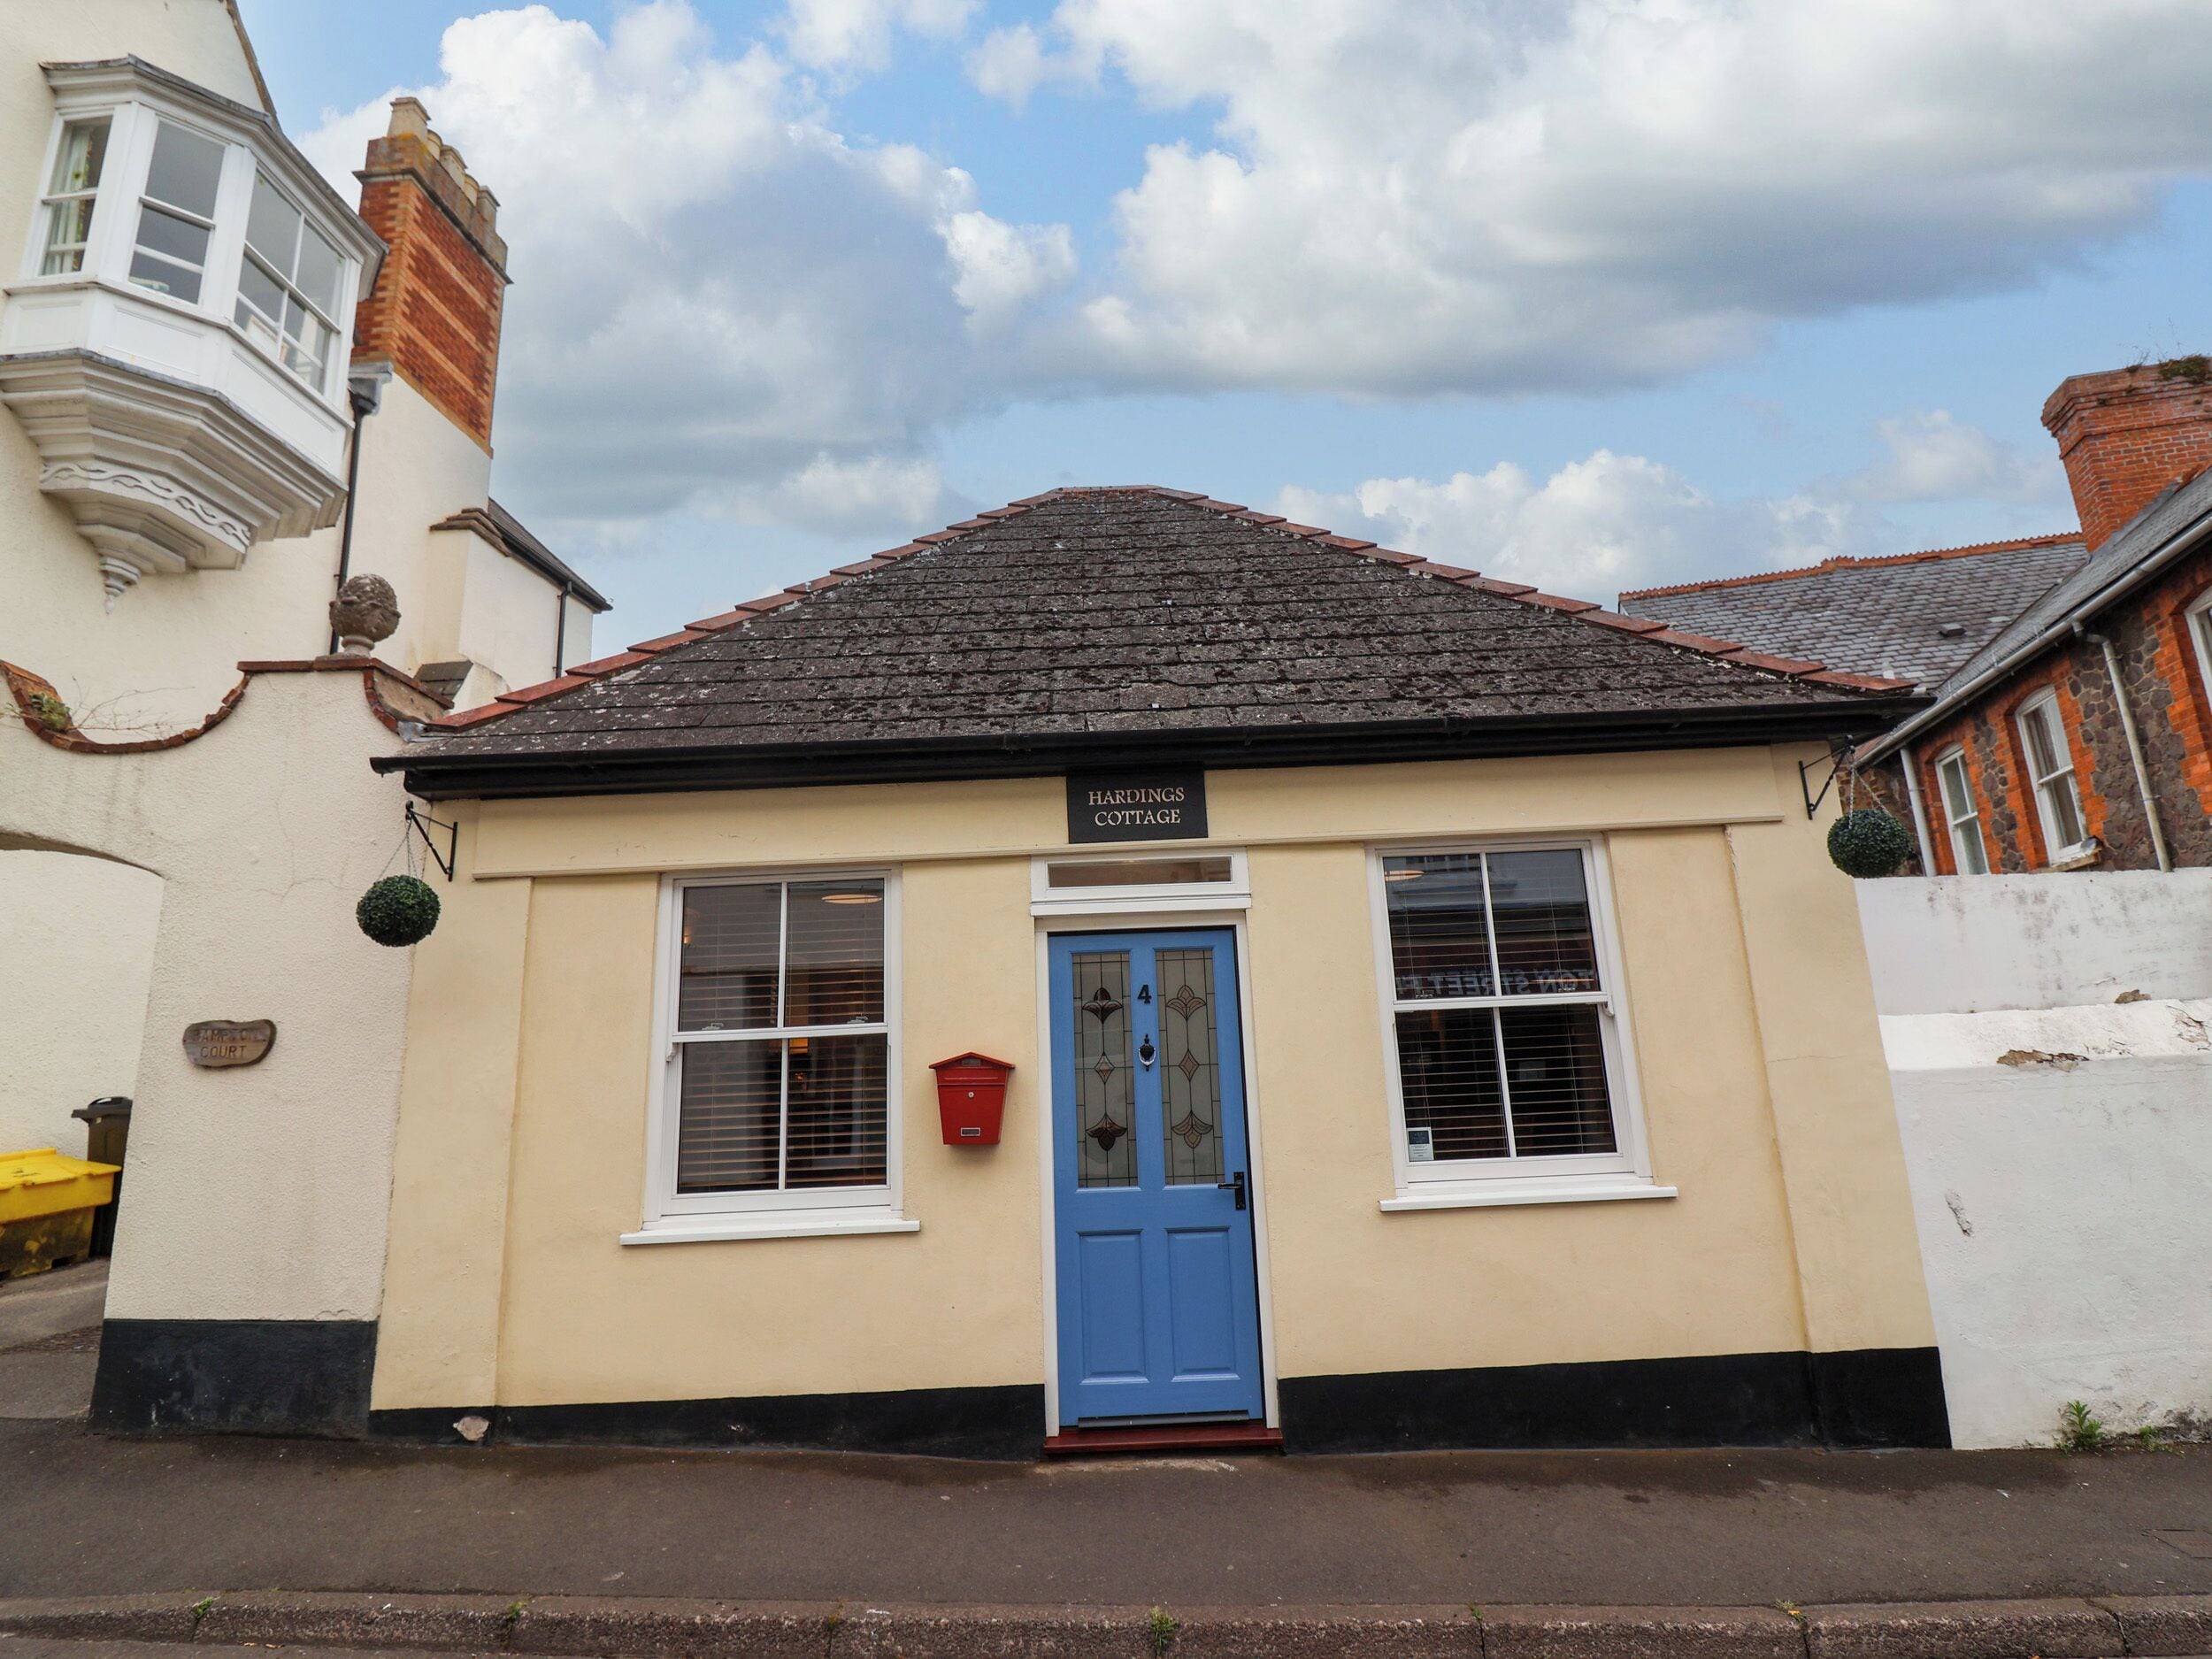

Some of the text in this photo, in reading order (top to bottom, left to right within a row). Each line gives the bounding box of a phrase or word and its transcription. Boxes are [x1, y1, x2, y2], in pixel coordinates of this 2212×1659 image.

[1088, 787, 1185, 806] HARDINGS
[1094, 809, 1181, 826] COTTAGE
[1137, 984, 1152, 1004] 4
[200, 1045, 248, 1059] COURT
